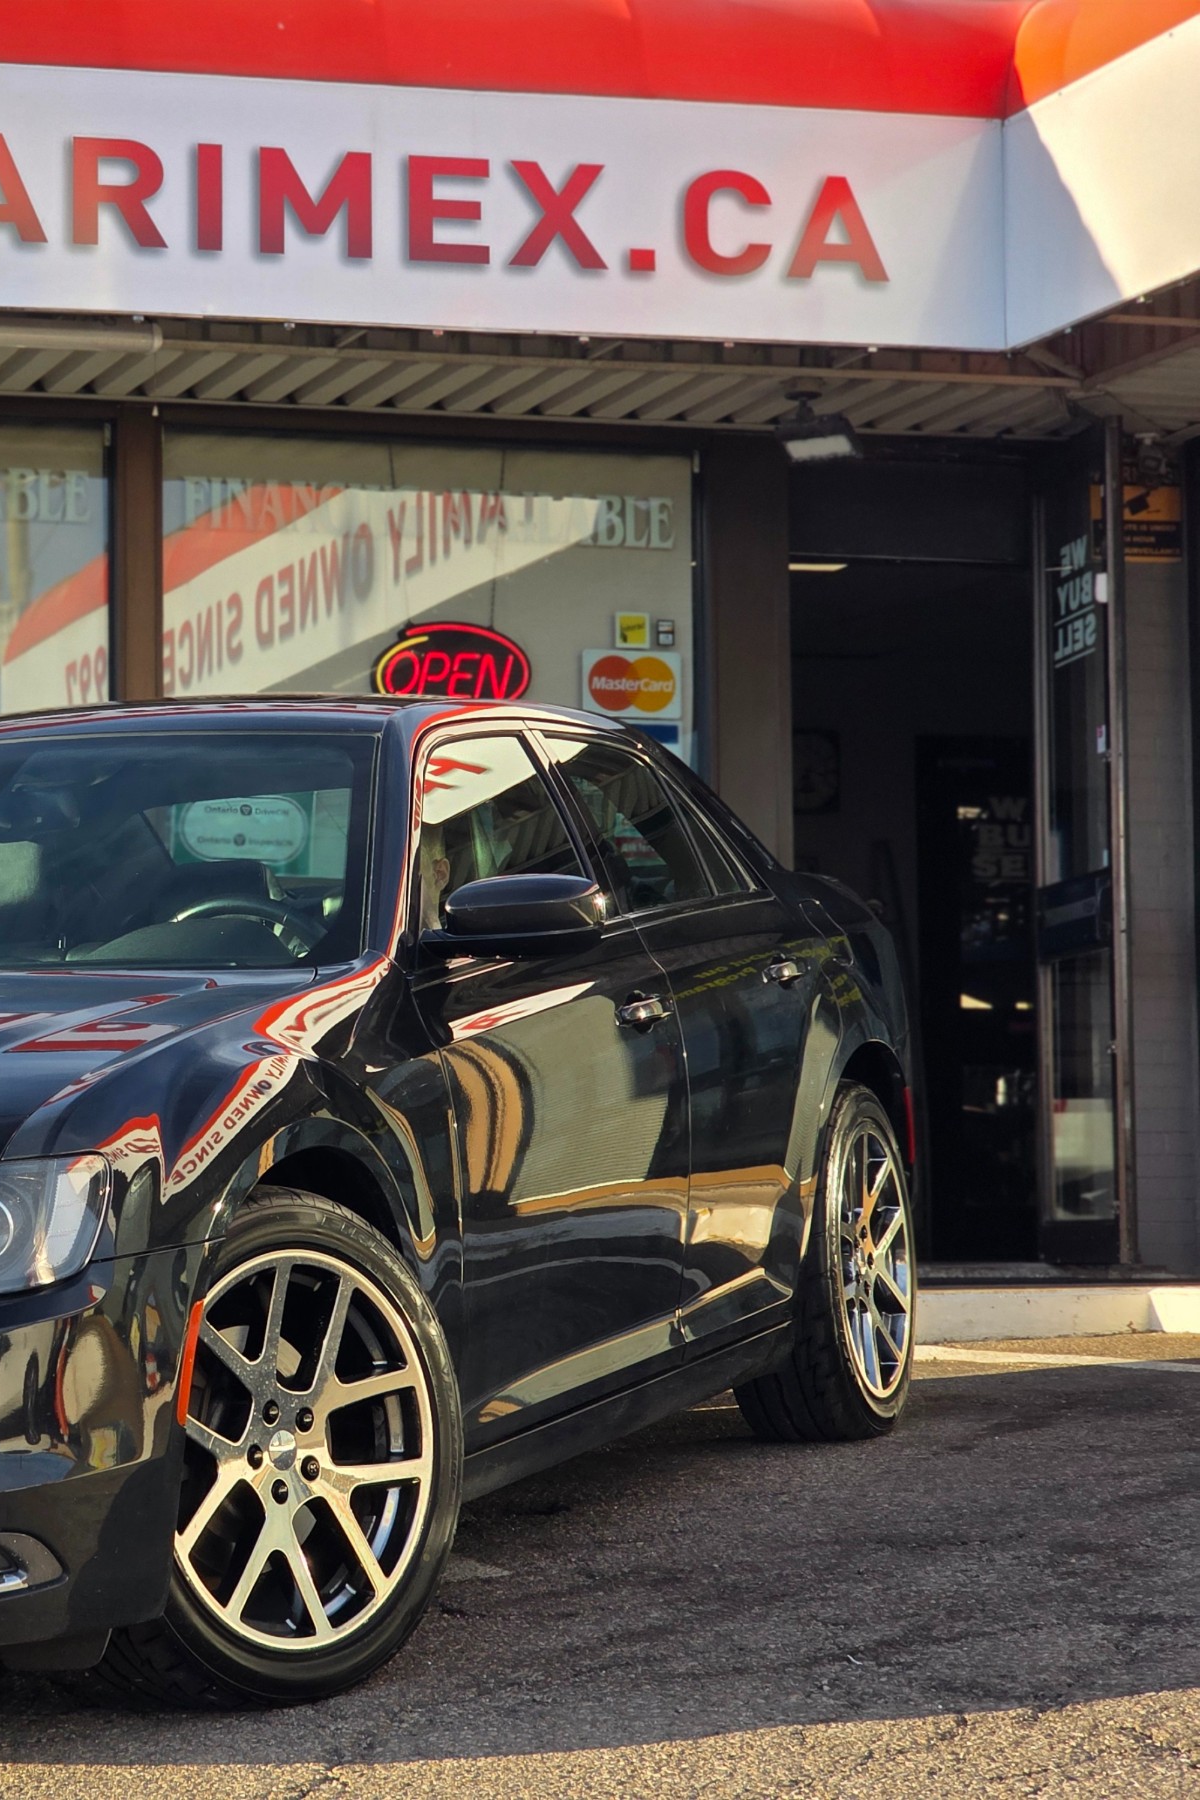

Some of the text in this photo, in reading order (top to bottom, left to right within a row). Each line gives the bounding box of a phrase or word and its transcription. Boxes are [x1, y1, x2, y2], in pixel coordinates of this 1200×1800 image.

[385, 650, 513, 699] OPEN
[589, 674, 674, 693] MasterCard
[204, 806, 238, 814] Ontario
